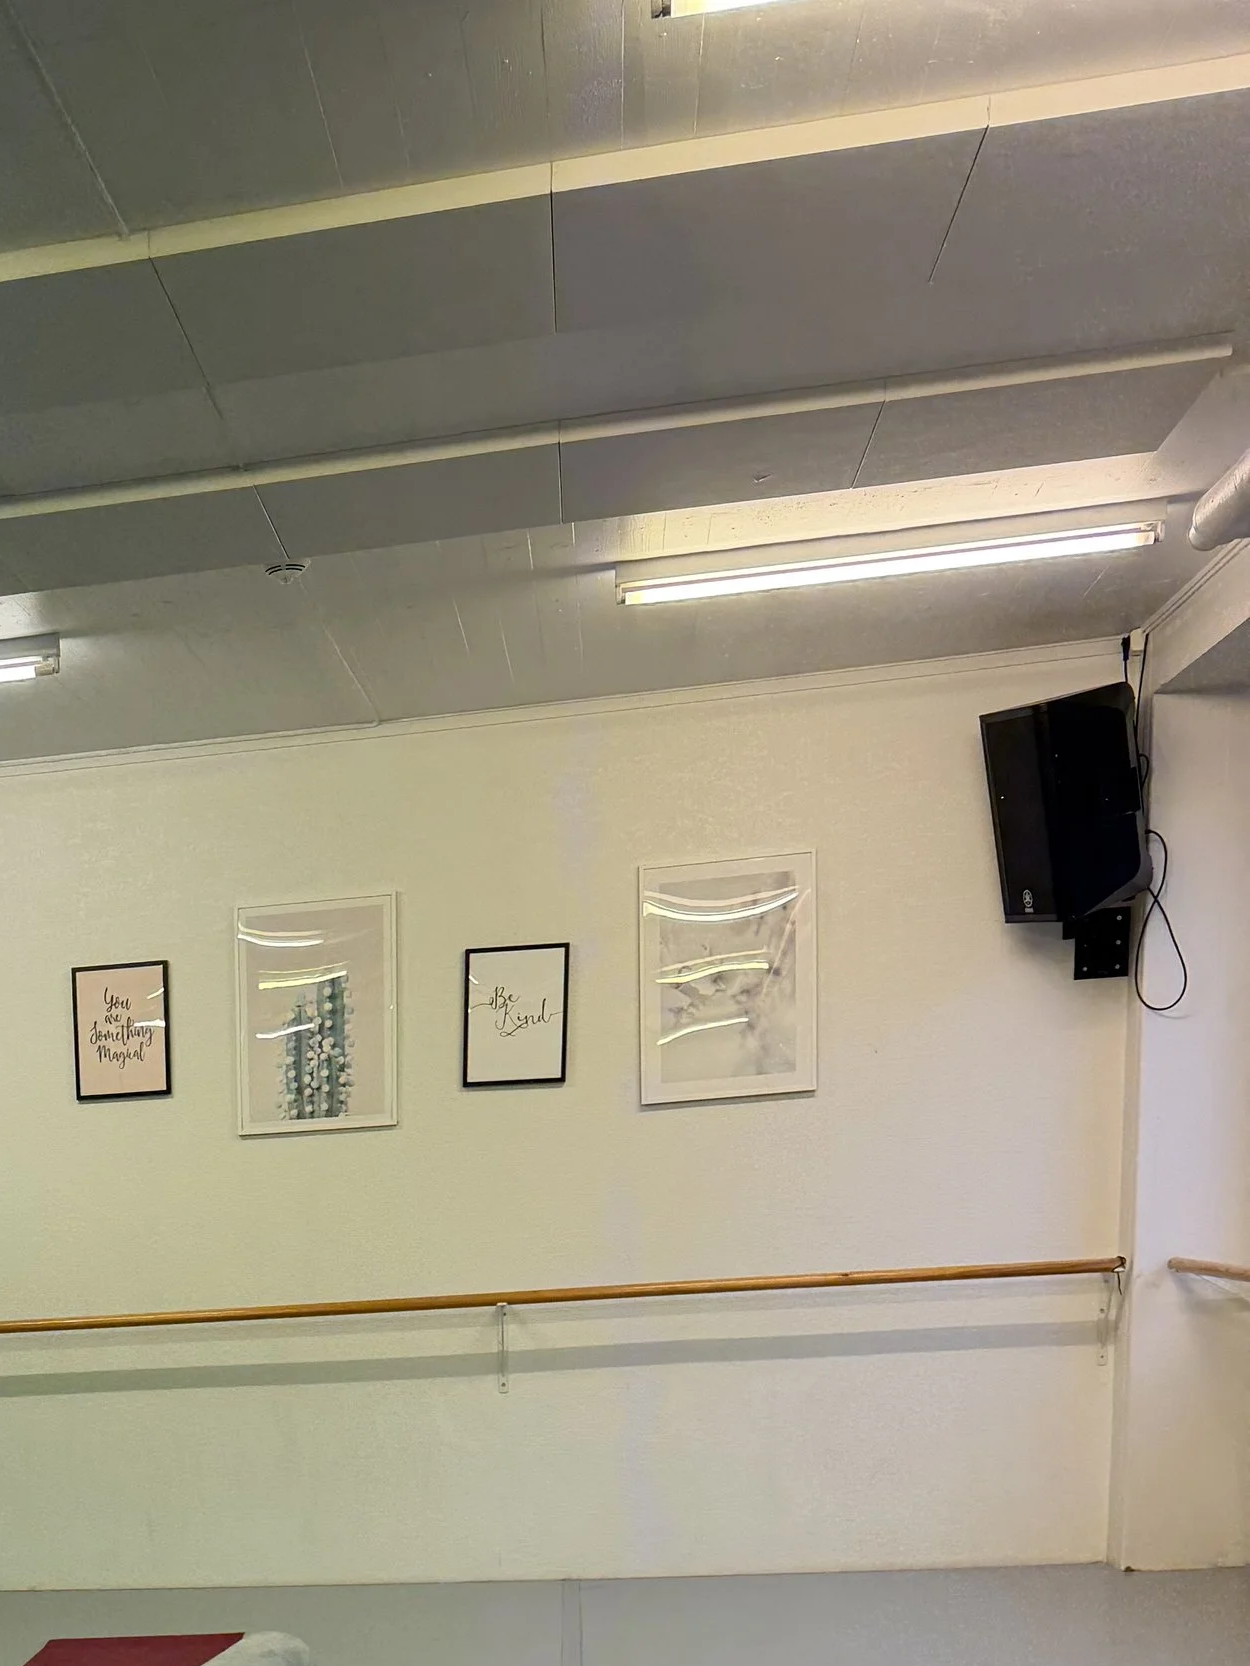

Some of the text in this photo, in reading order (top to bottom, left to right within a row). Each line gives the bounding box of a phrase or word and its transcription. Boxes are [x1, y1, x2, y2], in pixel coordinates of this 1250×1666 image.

[103, 987, 131, 1012] You
[484, 986, 520, 1010] Be
[104, 1013, 122, 1025] are
[495, 998, 554, 1037] Kind
[90, 1016, 154, 1047] Something
[96, 1041, 146, 1069] Magical
